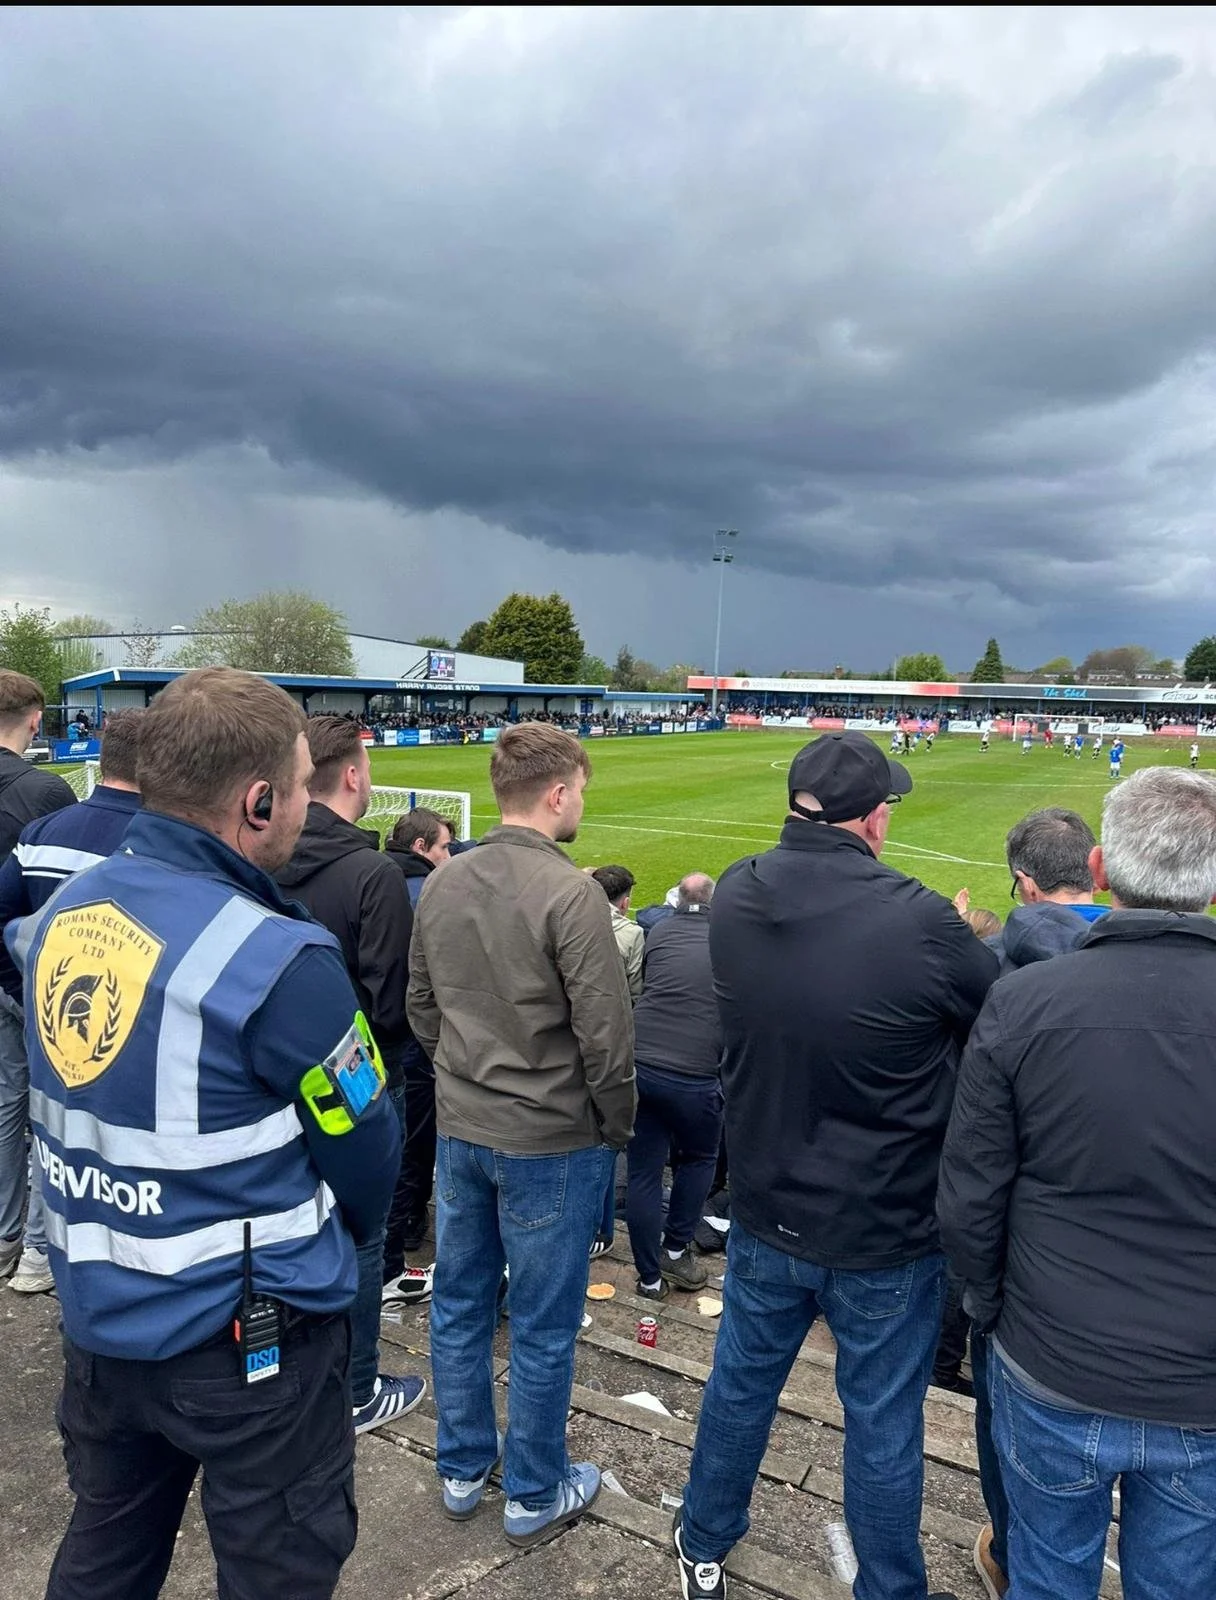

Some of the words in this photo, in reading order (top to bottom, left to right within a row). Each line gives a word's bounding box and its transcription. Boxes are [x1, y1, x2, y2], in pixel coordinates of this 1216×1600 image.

[1043, 688, 1059, 697] The
[1063, 688, 1087, 698] Shed
[56, 913, 98, 928] ROMANS
[100, 915, 153, 956] SECURITY
[69, 928, 125, 951] COMPANY
[82, 944, 105, 959] LTD
[34, 1134, 163, 1216] UPERVISOR
[247, 1346, 279, 1372] DSO
